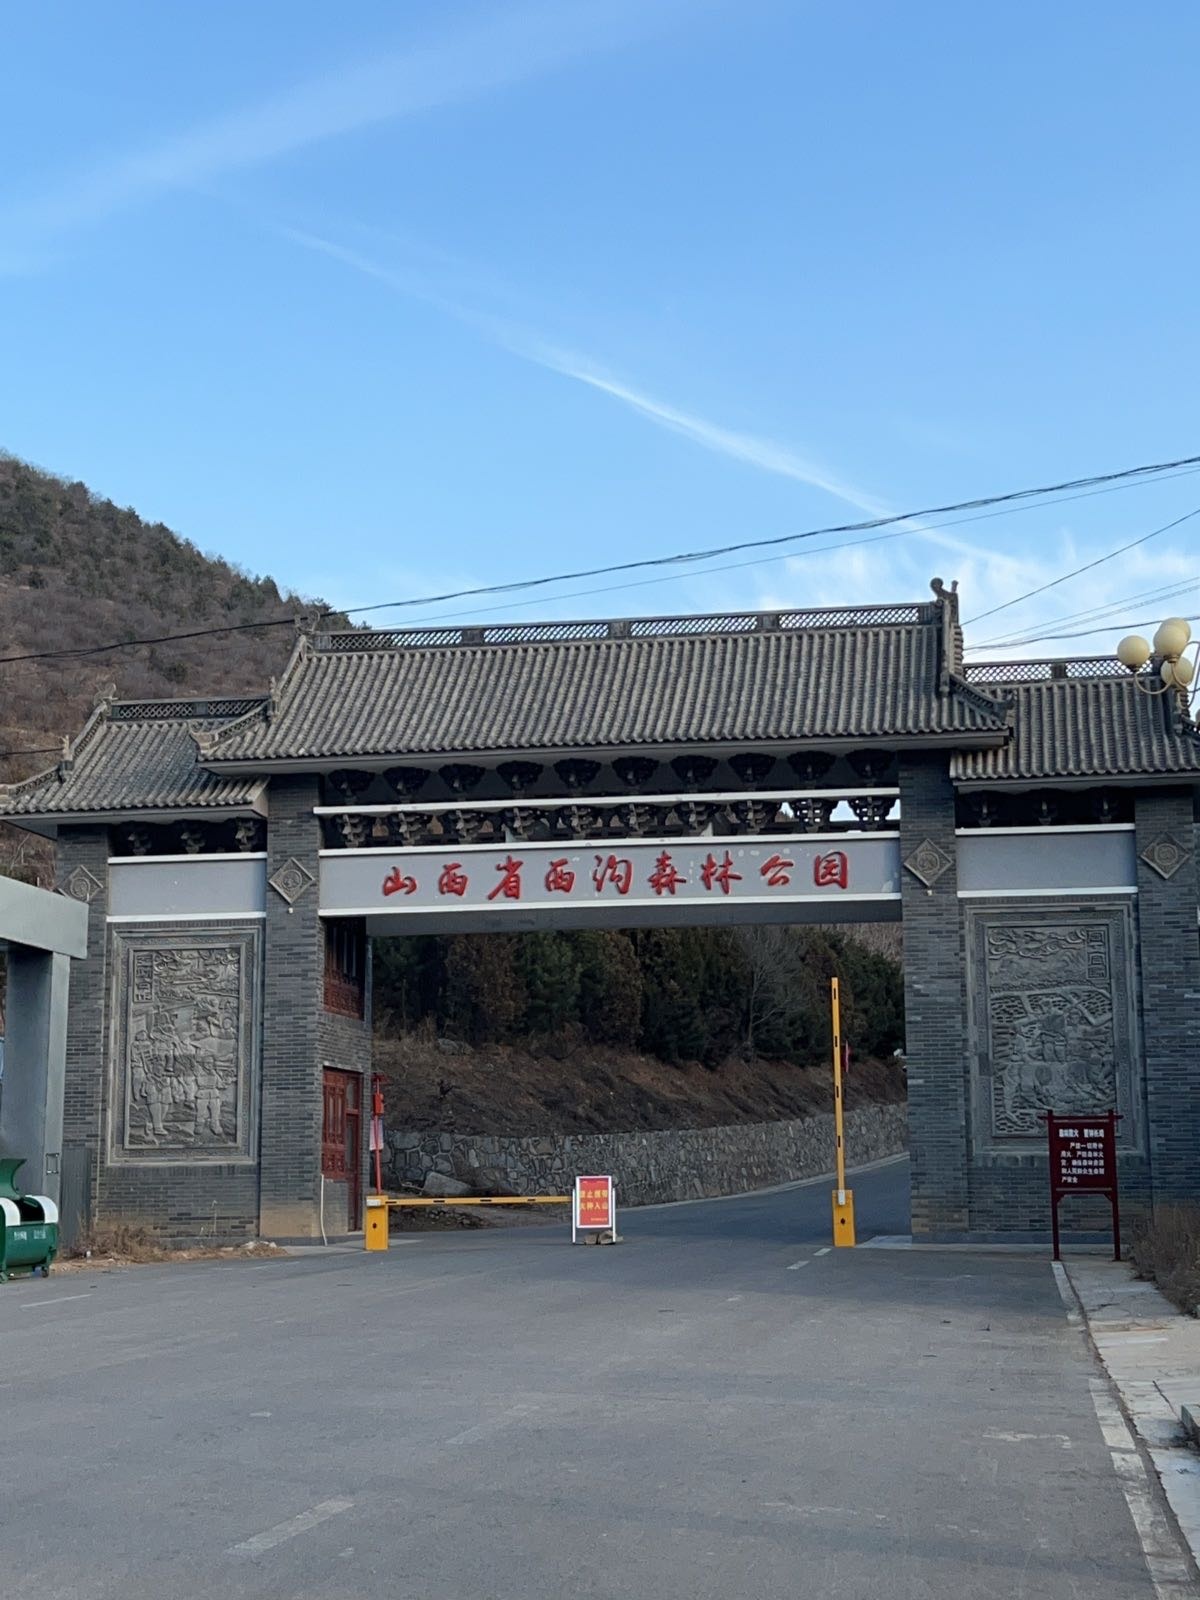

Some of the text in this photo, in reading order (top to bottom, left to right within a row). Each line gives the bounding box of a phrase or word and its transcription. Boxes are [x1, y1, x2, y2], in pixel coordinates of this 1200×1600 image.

[382, 850, 848, 901] 山西省西沟森林公园
